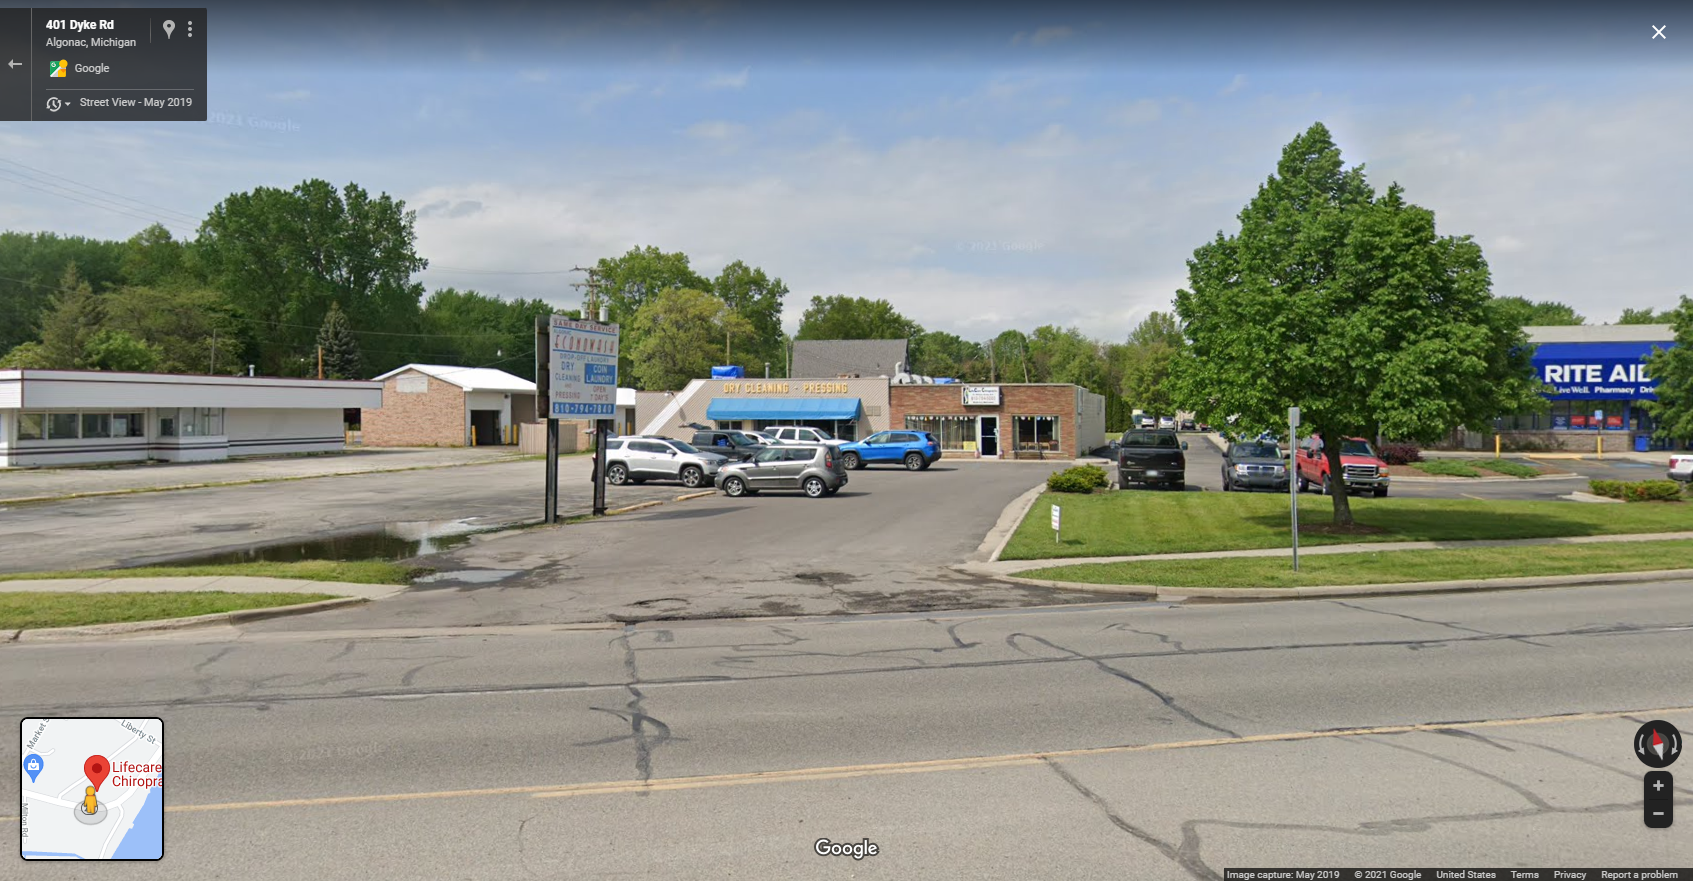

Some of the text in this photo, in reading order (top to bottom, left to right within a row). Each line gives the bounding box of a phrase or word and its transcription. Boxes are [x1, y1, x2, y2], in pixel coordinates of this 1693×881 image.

[553, 320, 573, 328] SAME
[589, 325, 615, 334] SERVICE
[561, 361, 575, 370] DRY
[593, 365, 607, 373] COIN
[555, 372, 580, 382] CLEANING
[1545, 364, 1602, 383] RITE
[586, 374, 613, 383] LAUNDRY
[723, 383, 741, 394] DRY
[744, 383, 789, 394] CLEANING
[803, 383, 848, 393] PRESSING
[1594, 386, 1635, 395] Pharmacy
[555, 391, 580, 399] PRESSING
